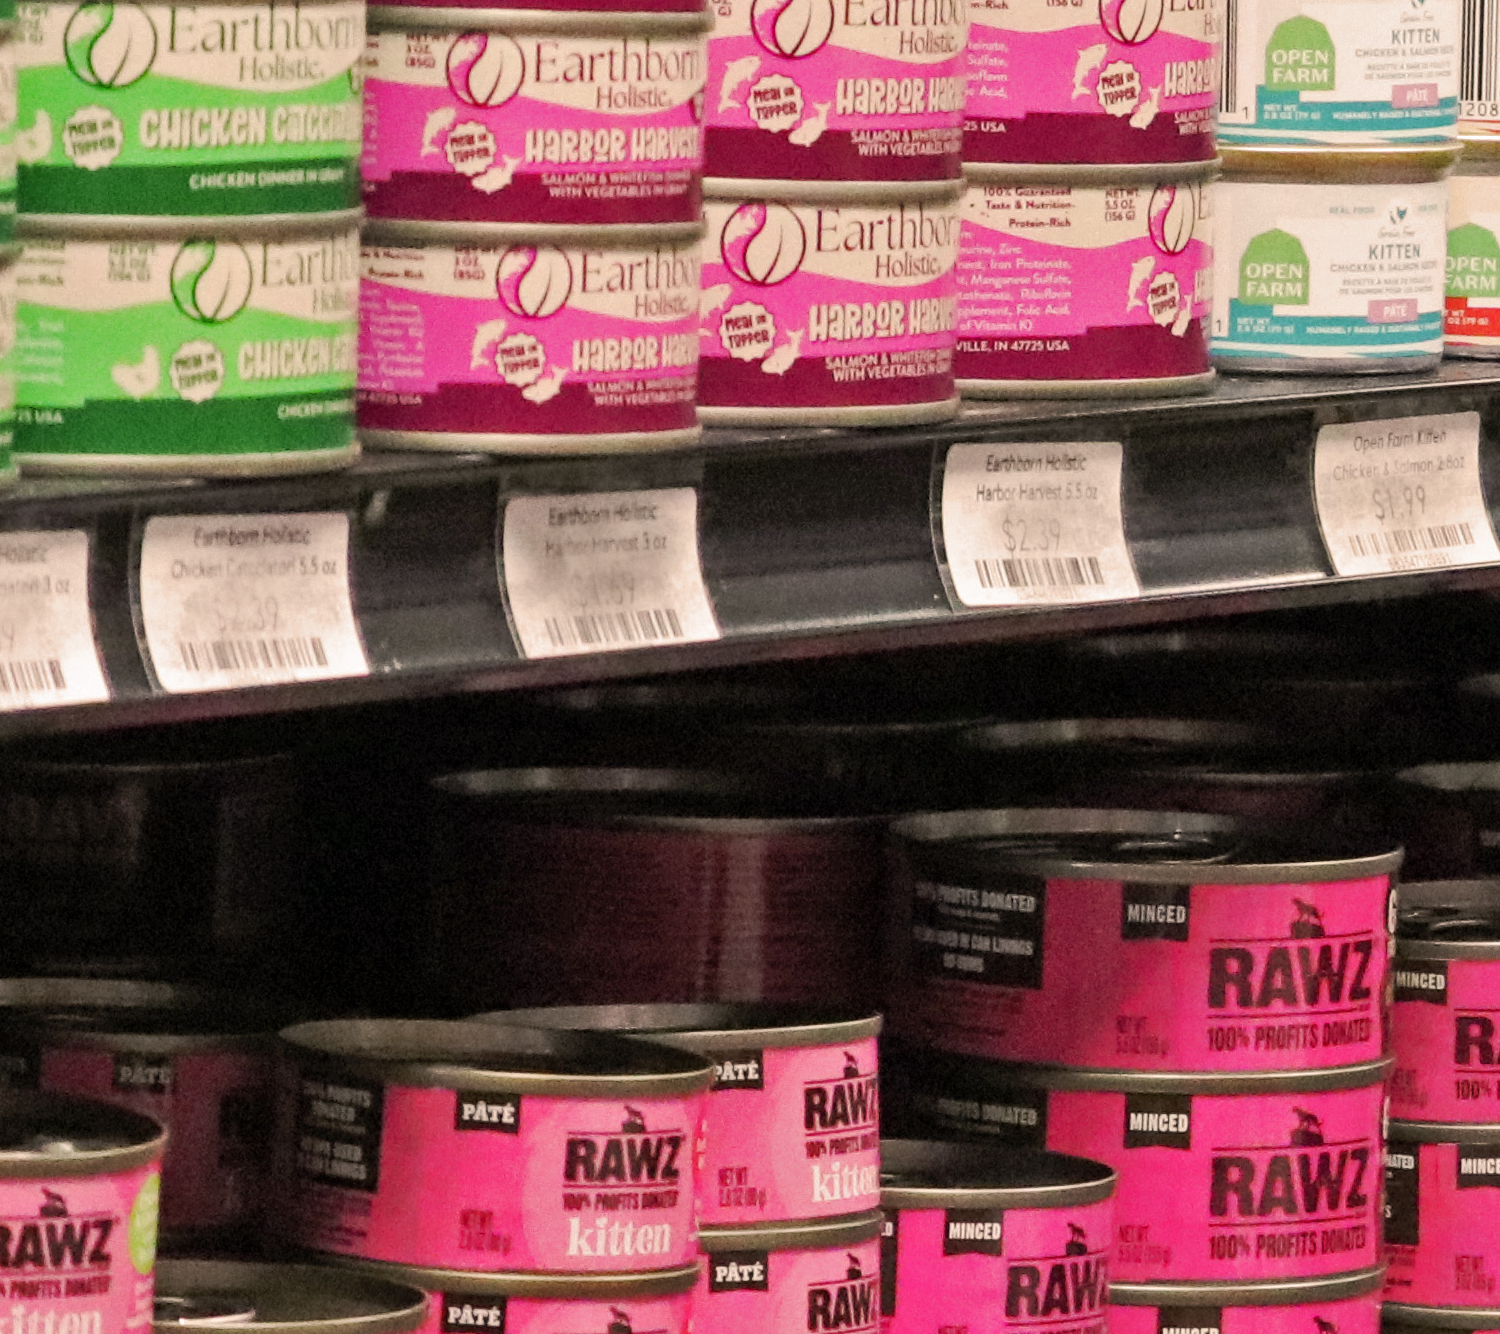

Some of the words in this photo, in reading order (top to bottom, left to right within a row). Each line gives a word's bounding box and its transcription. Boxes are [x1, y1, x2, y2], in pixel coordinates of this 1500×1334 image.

[1390, 29, 1441, 44] KITTEN
[1272, 49, 1329, 65] OPEN
[1272, 68, 1329, 83] FARM
[986, 201, 1011, 210] Taste
[1014, 201, 1022, 210] &
[1026, 201, 1072, 210] Nutrition
[1009, 218, 1071, 228] Protein-Rich
[1367, 244, 1421, 260] KITTEN
[995, 342, 1008, 351] IN
[1010, 341, 1043, 351] 47725
[1047, 341, 1070, 351] USA
[1354, 434, 1385, 452] Open
[1387, 432, 1413, 449] Farm
[986, 455, 1042, 473] Earthborn
[976, 484, 1016, 501] Harbor
[1019, 483, 1061, 501] Harvest
[1372, 485, 1426, 521] $1.99
[1002, 519, 1060, 554] $2.39
[1128, 904, 1187, 925] MINCED
[1208, 940, 1373, 1011] RAWZ
[1207, 1025, 1249, 1052] 100%
[1255, 1023, 1319, 1049] PROFITS
[1323, 1019, 1371, 1045] DONATED
[462, 1100, 516, 1123] PÂTÉ
[567, 1217, 672, 1258] kitten
